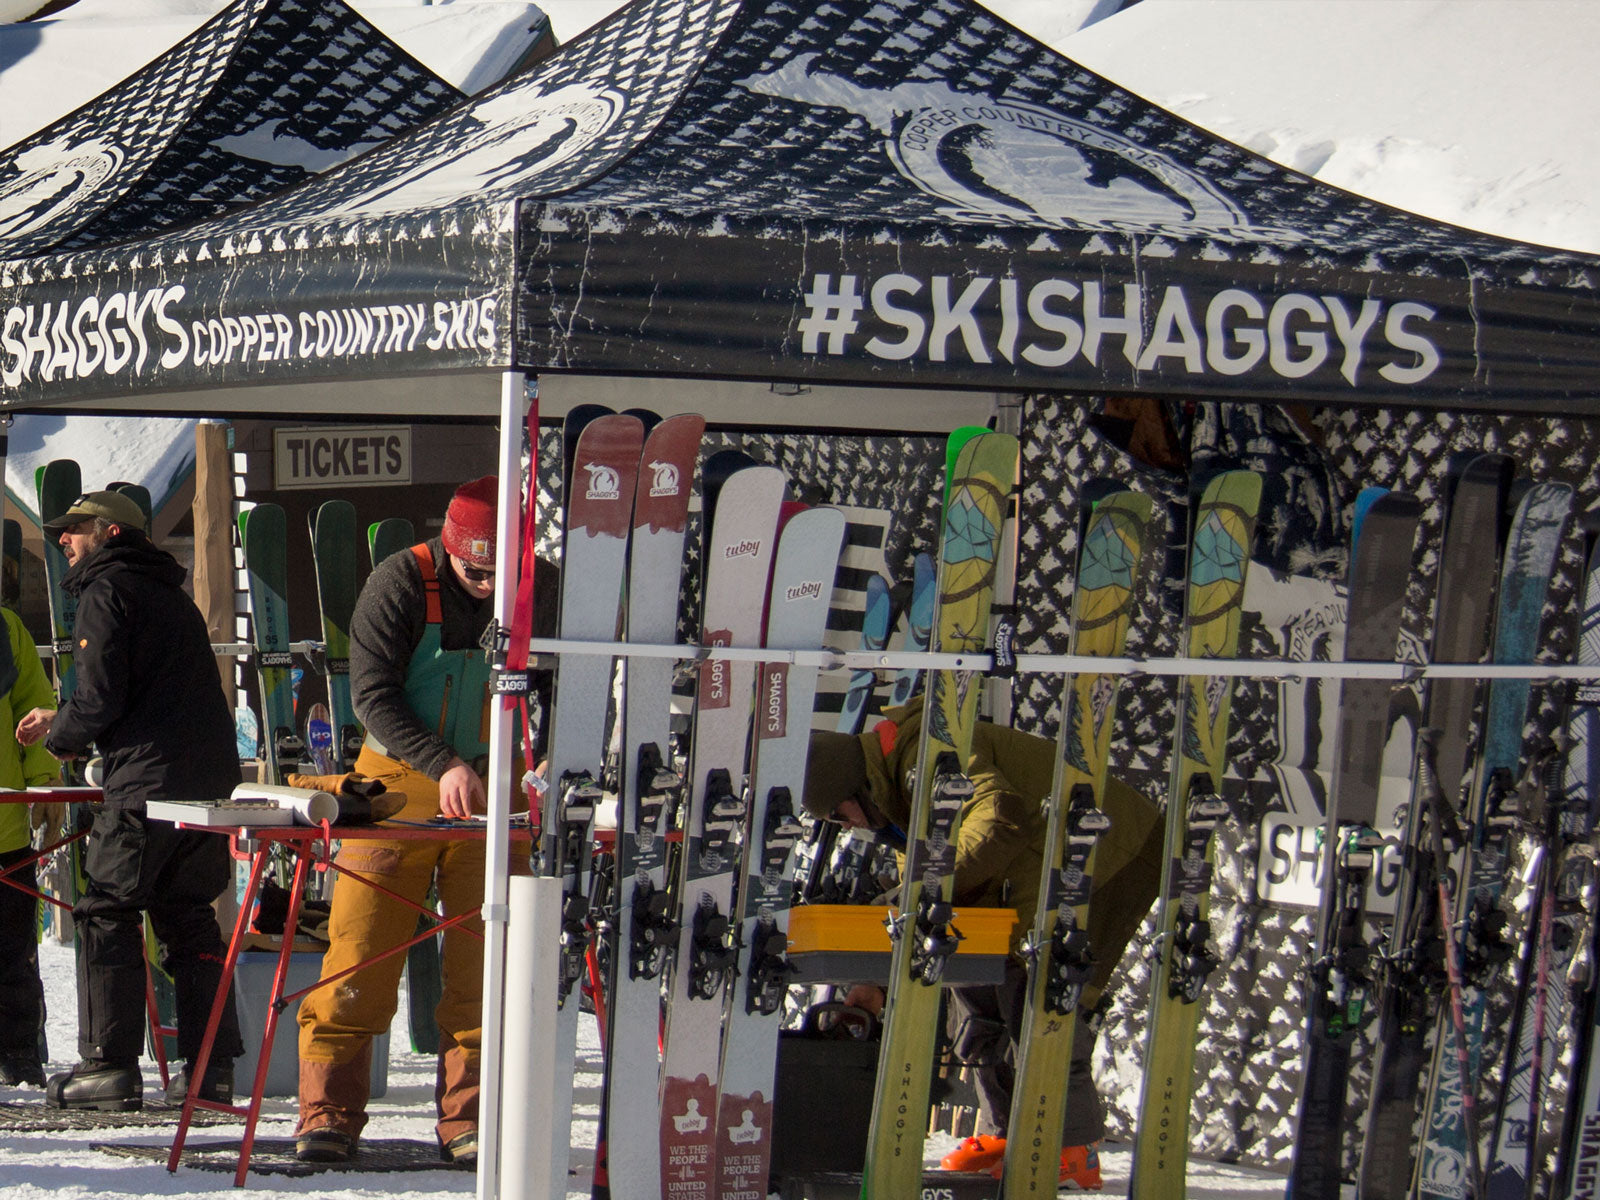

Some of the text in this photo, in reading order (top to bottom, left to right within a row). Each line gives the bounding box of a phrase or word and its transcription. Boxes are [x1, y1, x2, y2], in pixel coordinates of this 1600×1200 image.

[903, 108, 962, 152] COPPER
[962, 106, 1092, 142] COUNTRY
[1, 284, 497, 388] SHAGGY'S COPPER COUNTRY SKIS
[797, 273, 1441, 388] #SKISHAGGYS
[286, 434, 402, 478] TICKETS
[587, 491, 618, 499] SHAGGY'S
[650, 486, 678, 496] SHAGGY'S
[725, 540, 761, 558] tubby
[787, 582, 822, 600] tubby
[711, 638, 724, 699] SAGGY'S
[767, 672, 782, 732] SHAGGY'S
[894, 1062, 911, 1157] SHAGGYS
[1157, 1076, 1173, 1170] SHAGGYS
[669, 1145, 708, 1155] WE THE
[1029, 1095, 1047, 1192] SHAGGYS
[669, 1155, 707, 1165] PEOPLE
[723, 1165, 760, 1175] PEOPLE
[724, 1155, 761, 1166] WE THE
[668, 1181, 706, 1191] UNITED
